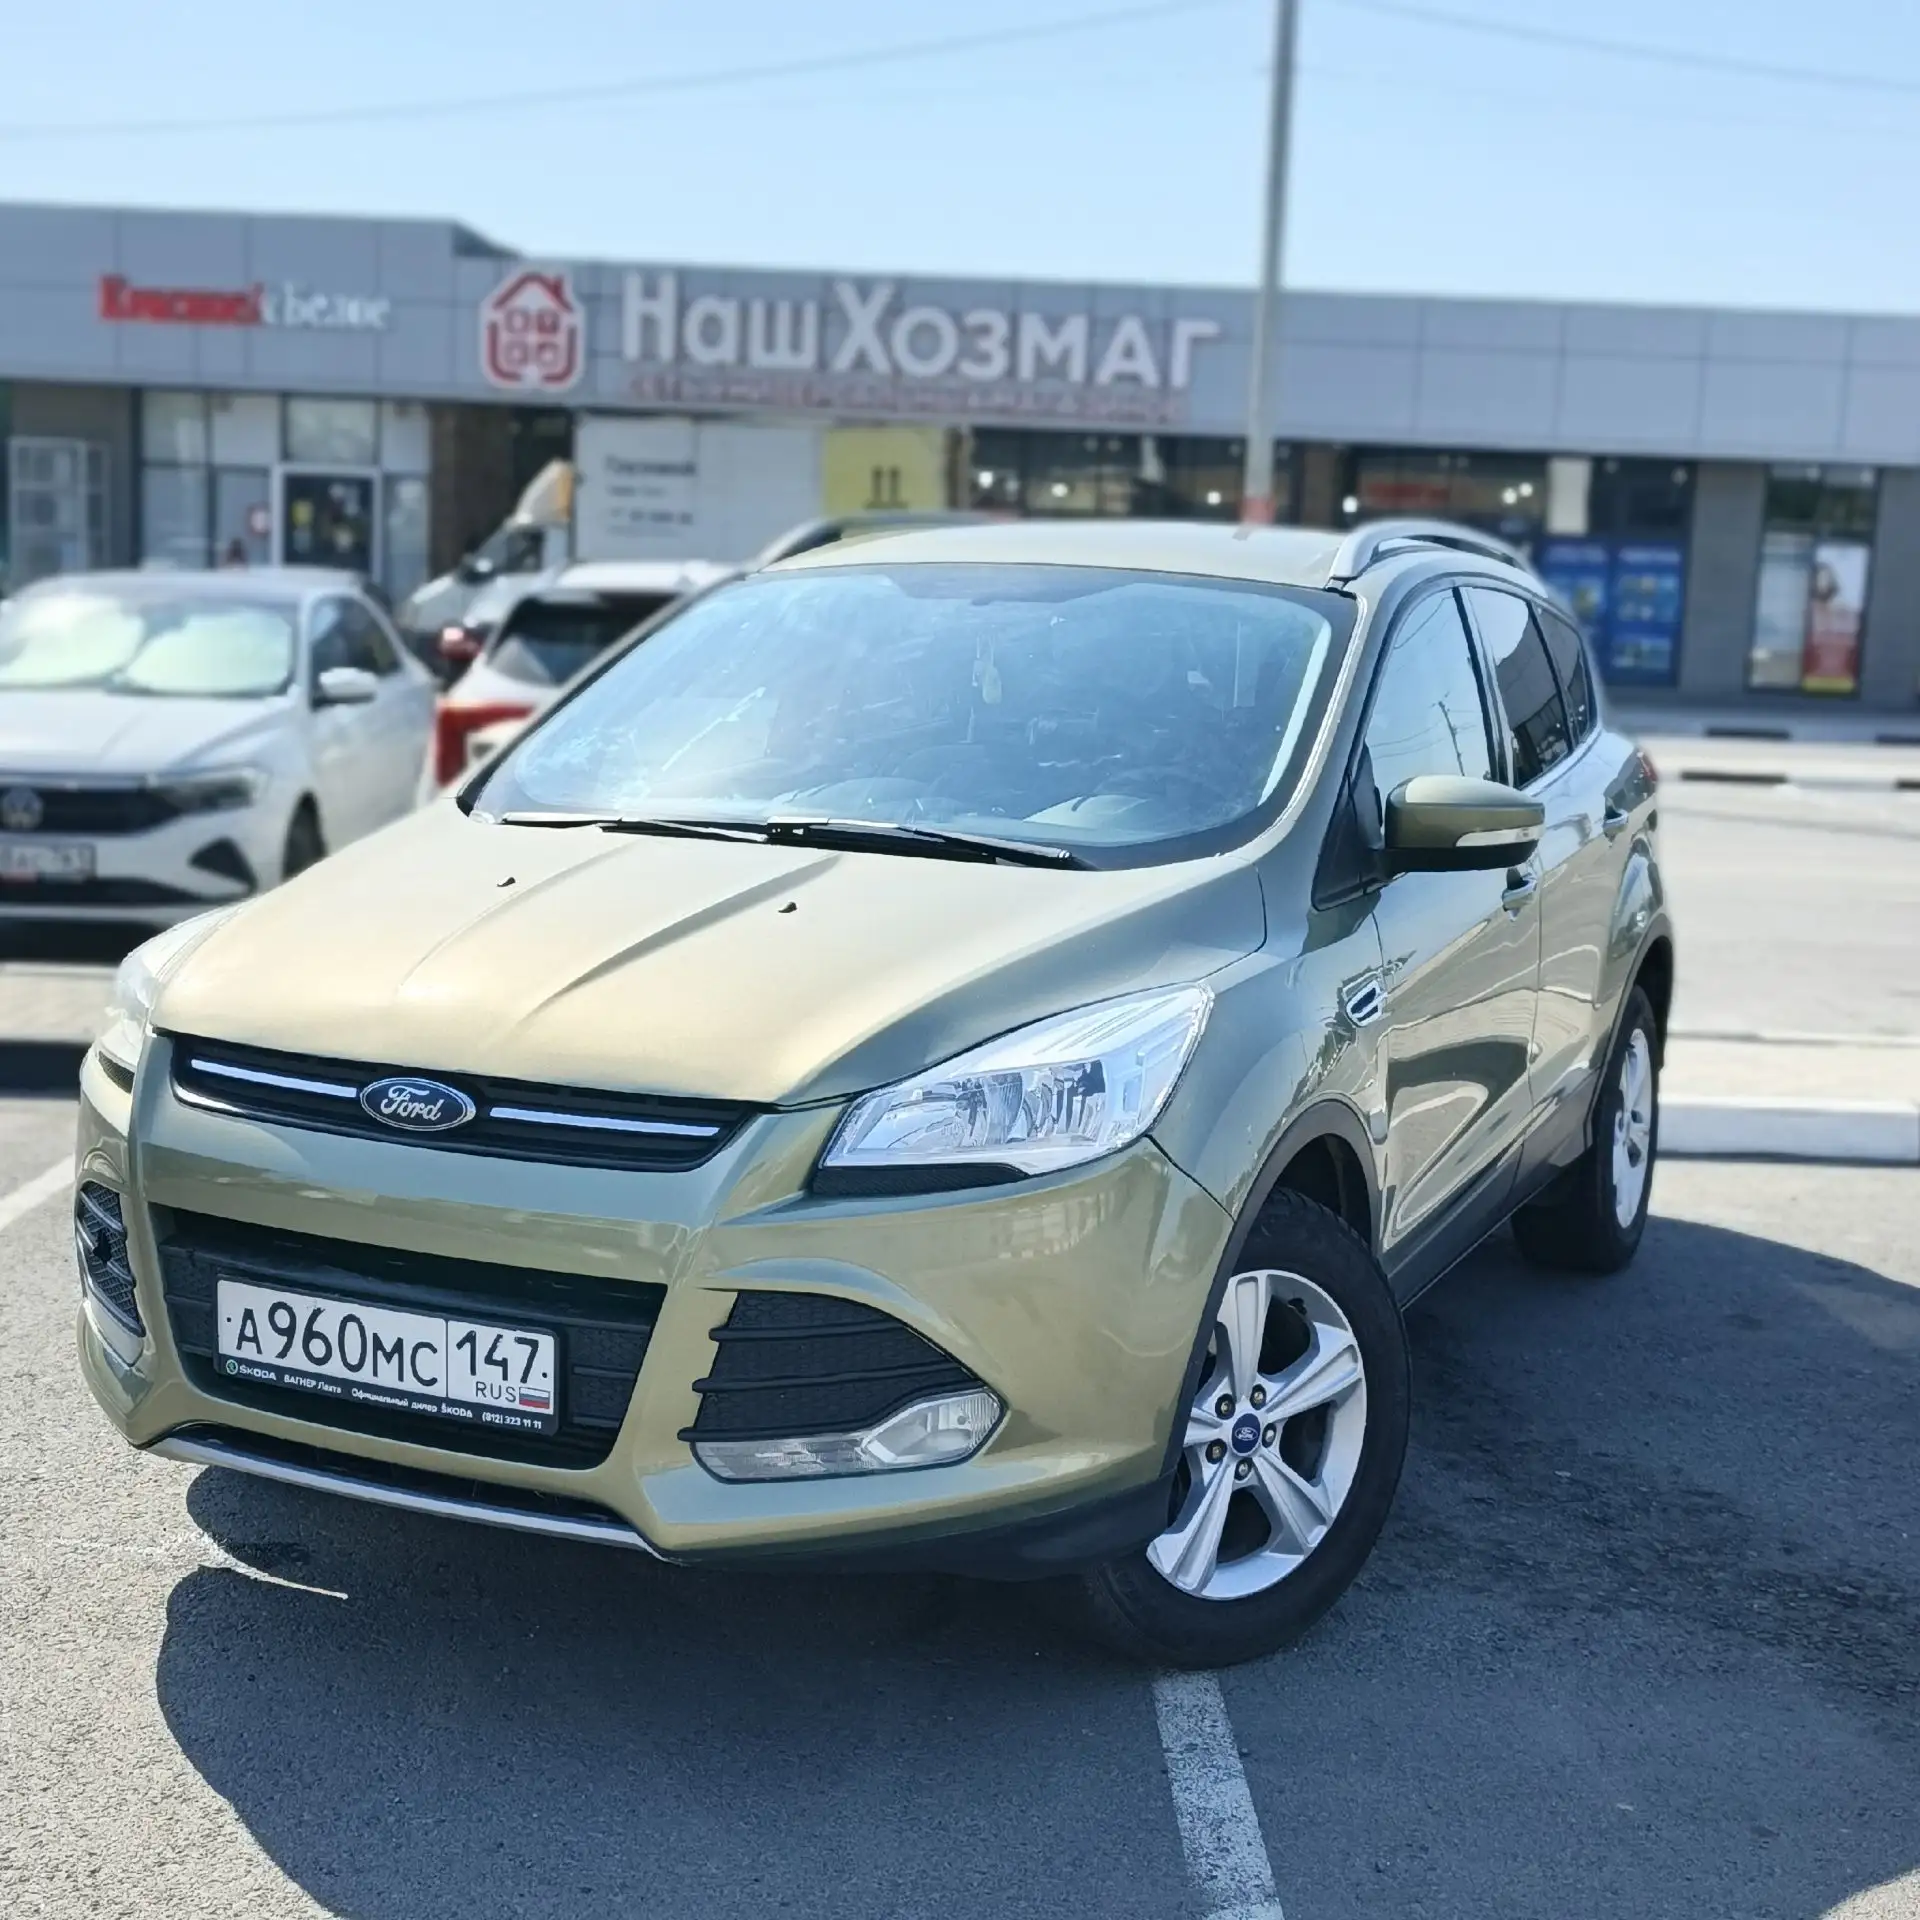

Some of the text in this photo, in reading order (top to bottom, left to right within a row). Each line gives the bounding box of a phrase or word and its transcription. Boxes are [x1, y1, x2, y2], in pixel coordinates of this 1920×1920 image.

[380, 1085, 444, 1121] Ford
[235, 1301, 540, 1387] А960МС 147
[283, 1374, 317, 1388] ВАГНЕР
[351, 1387, 409, 1407] Официальный
[482, 1411, 503, 1424] (812)
[504, 1415, 521, 1426] 323
[523, 1419, 531, 1428] 11
[533, 1420, 542, 1430] 11
[475, 1381, 517, 1403] RUS
